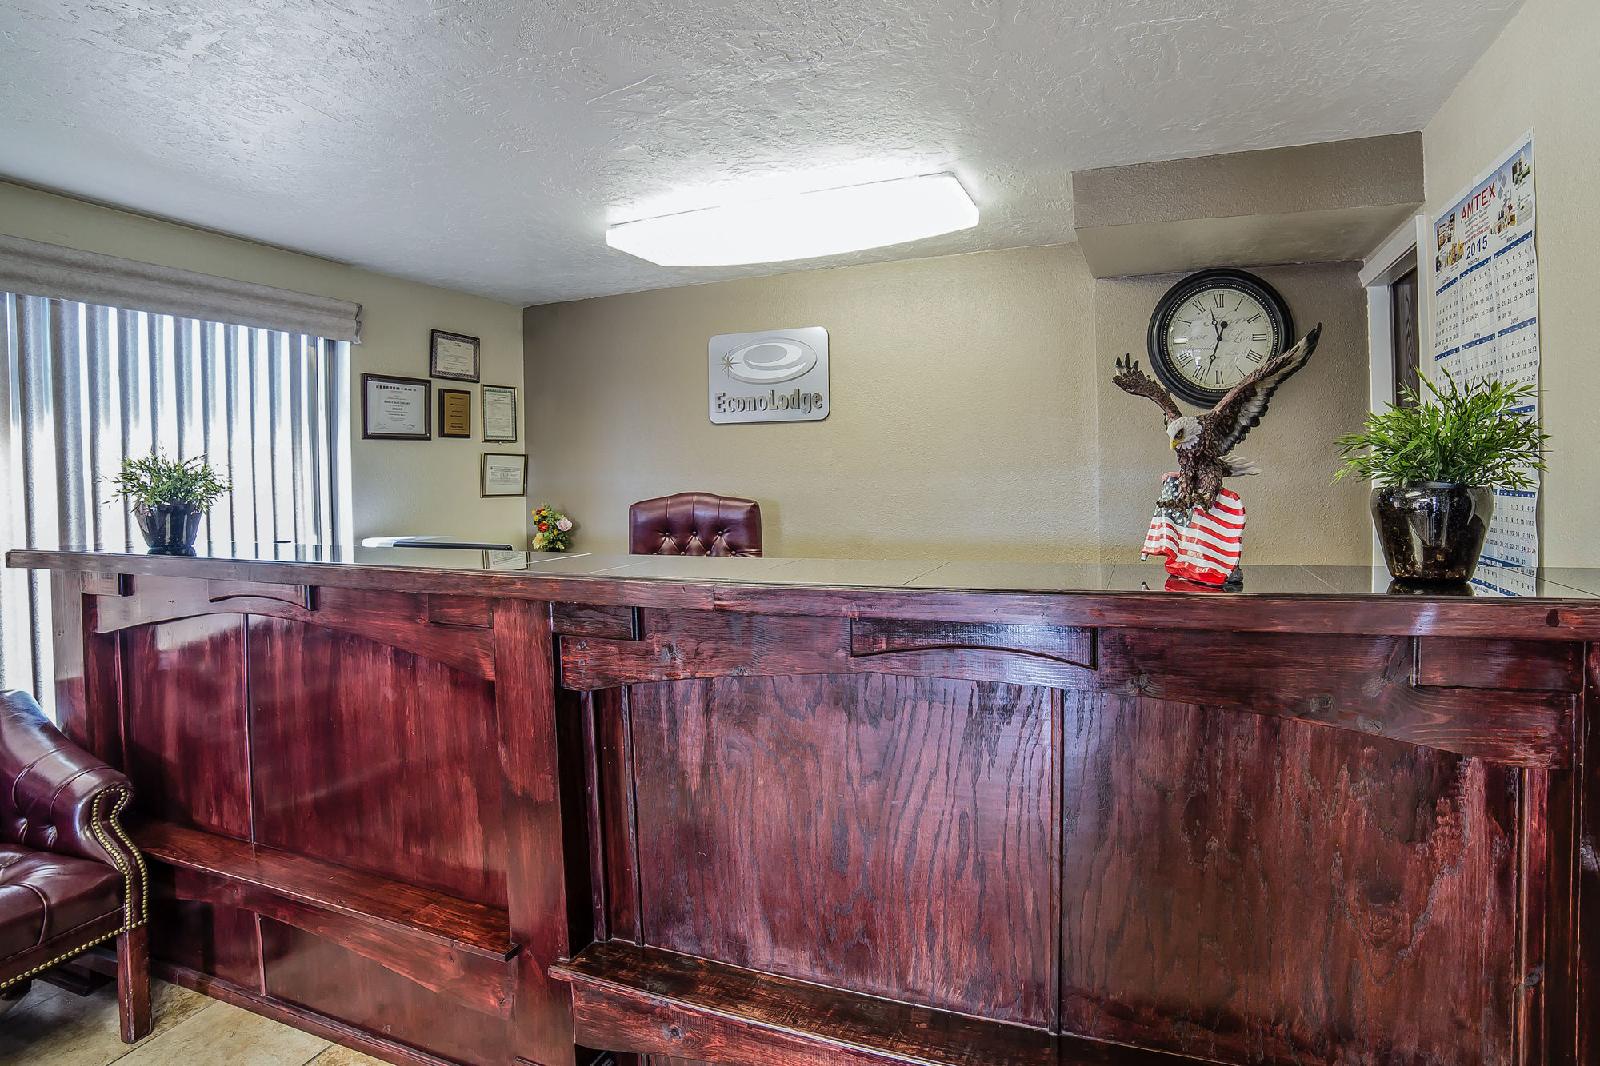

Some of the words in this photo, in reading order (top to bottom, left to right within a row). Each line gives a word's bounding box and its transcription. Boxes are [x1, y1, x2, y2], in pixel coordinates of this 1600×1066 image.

[1461, 182, 1496, 220] AMTEX
[1466, 235, 1488, 260] 2015
[714, 388, 823, 415] EconoLodge
